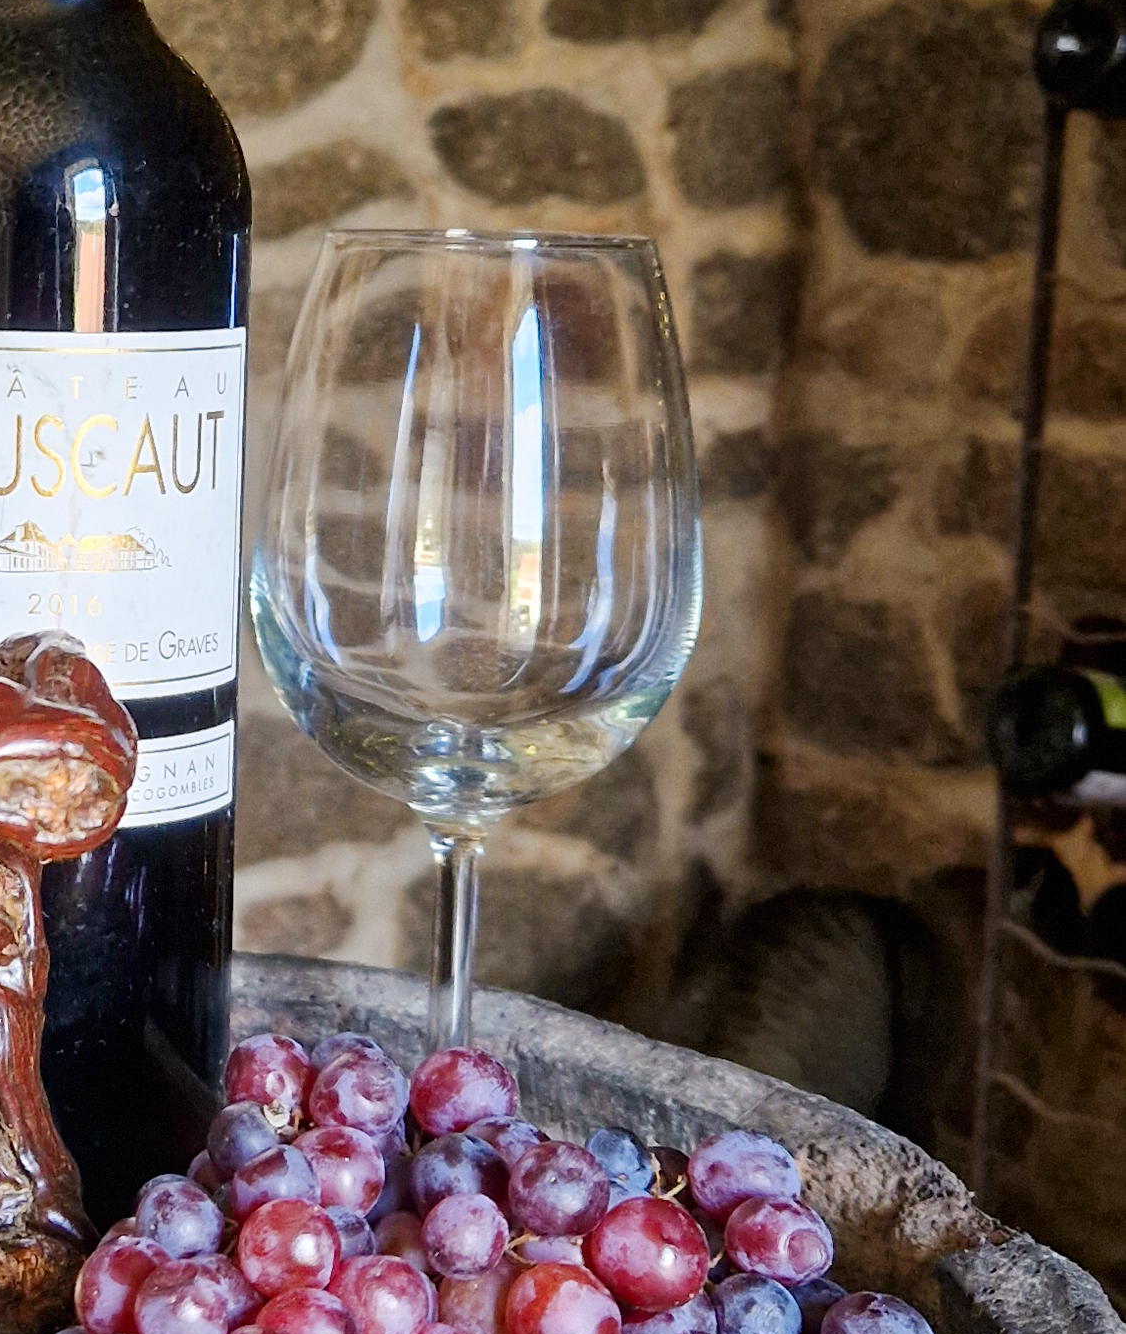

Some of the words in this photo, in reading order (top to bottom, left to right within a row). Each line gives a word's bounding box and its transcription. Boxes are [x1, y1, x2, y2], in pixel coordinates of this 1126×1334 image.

[27, 592, 102, 617] 2016
[125, 641, 149, 663] DE
[158, 630, 220, 660] GRAVES
[137, 752, 215, 783] GNAN
[131, 776, 215, 802] COGOMBLES
